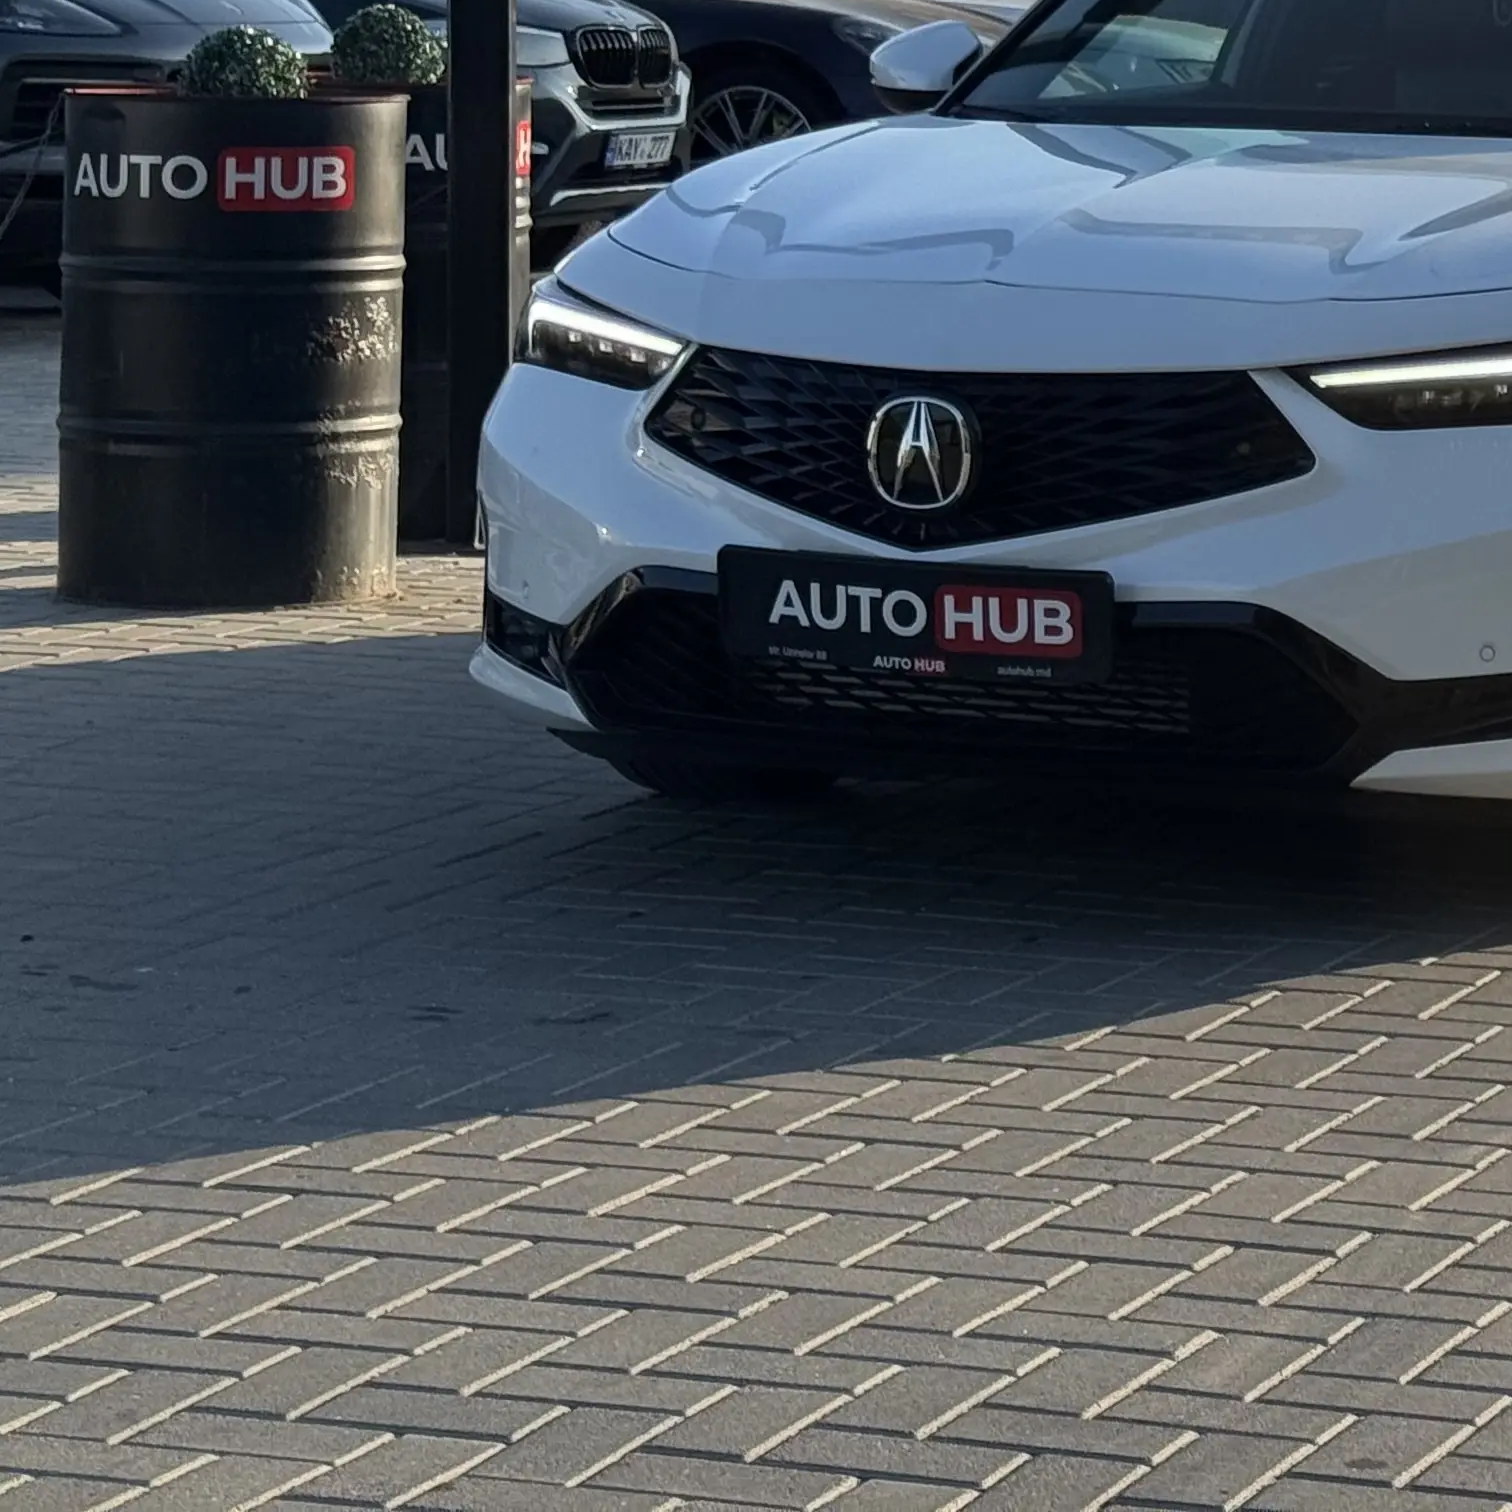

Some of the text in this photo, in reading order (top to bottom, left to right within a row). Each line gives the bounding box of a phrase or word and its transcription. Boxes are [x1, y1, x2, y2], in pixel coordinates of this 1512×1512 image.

[74, 152, 347, 200] AUTO HUB
[769, 579, 1076, 646] AUTO HUB
[872, 655, 946, 673] AUTO HUB
